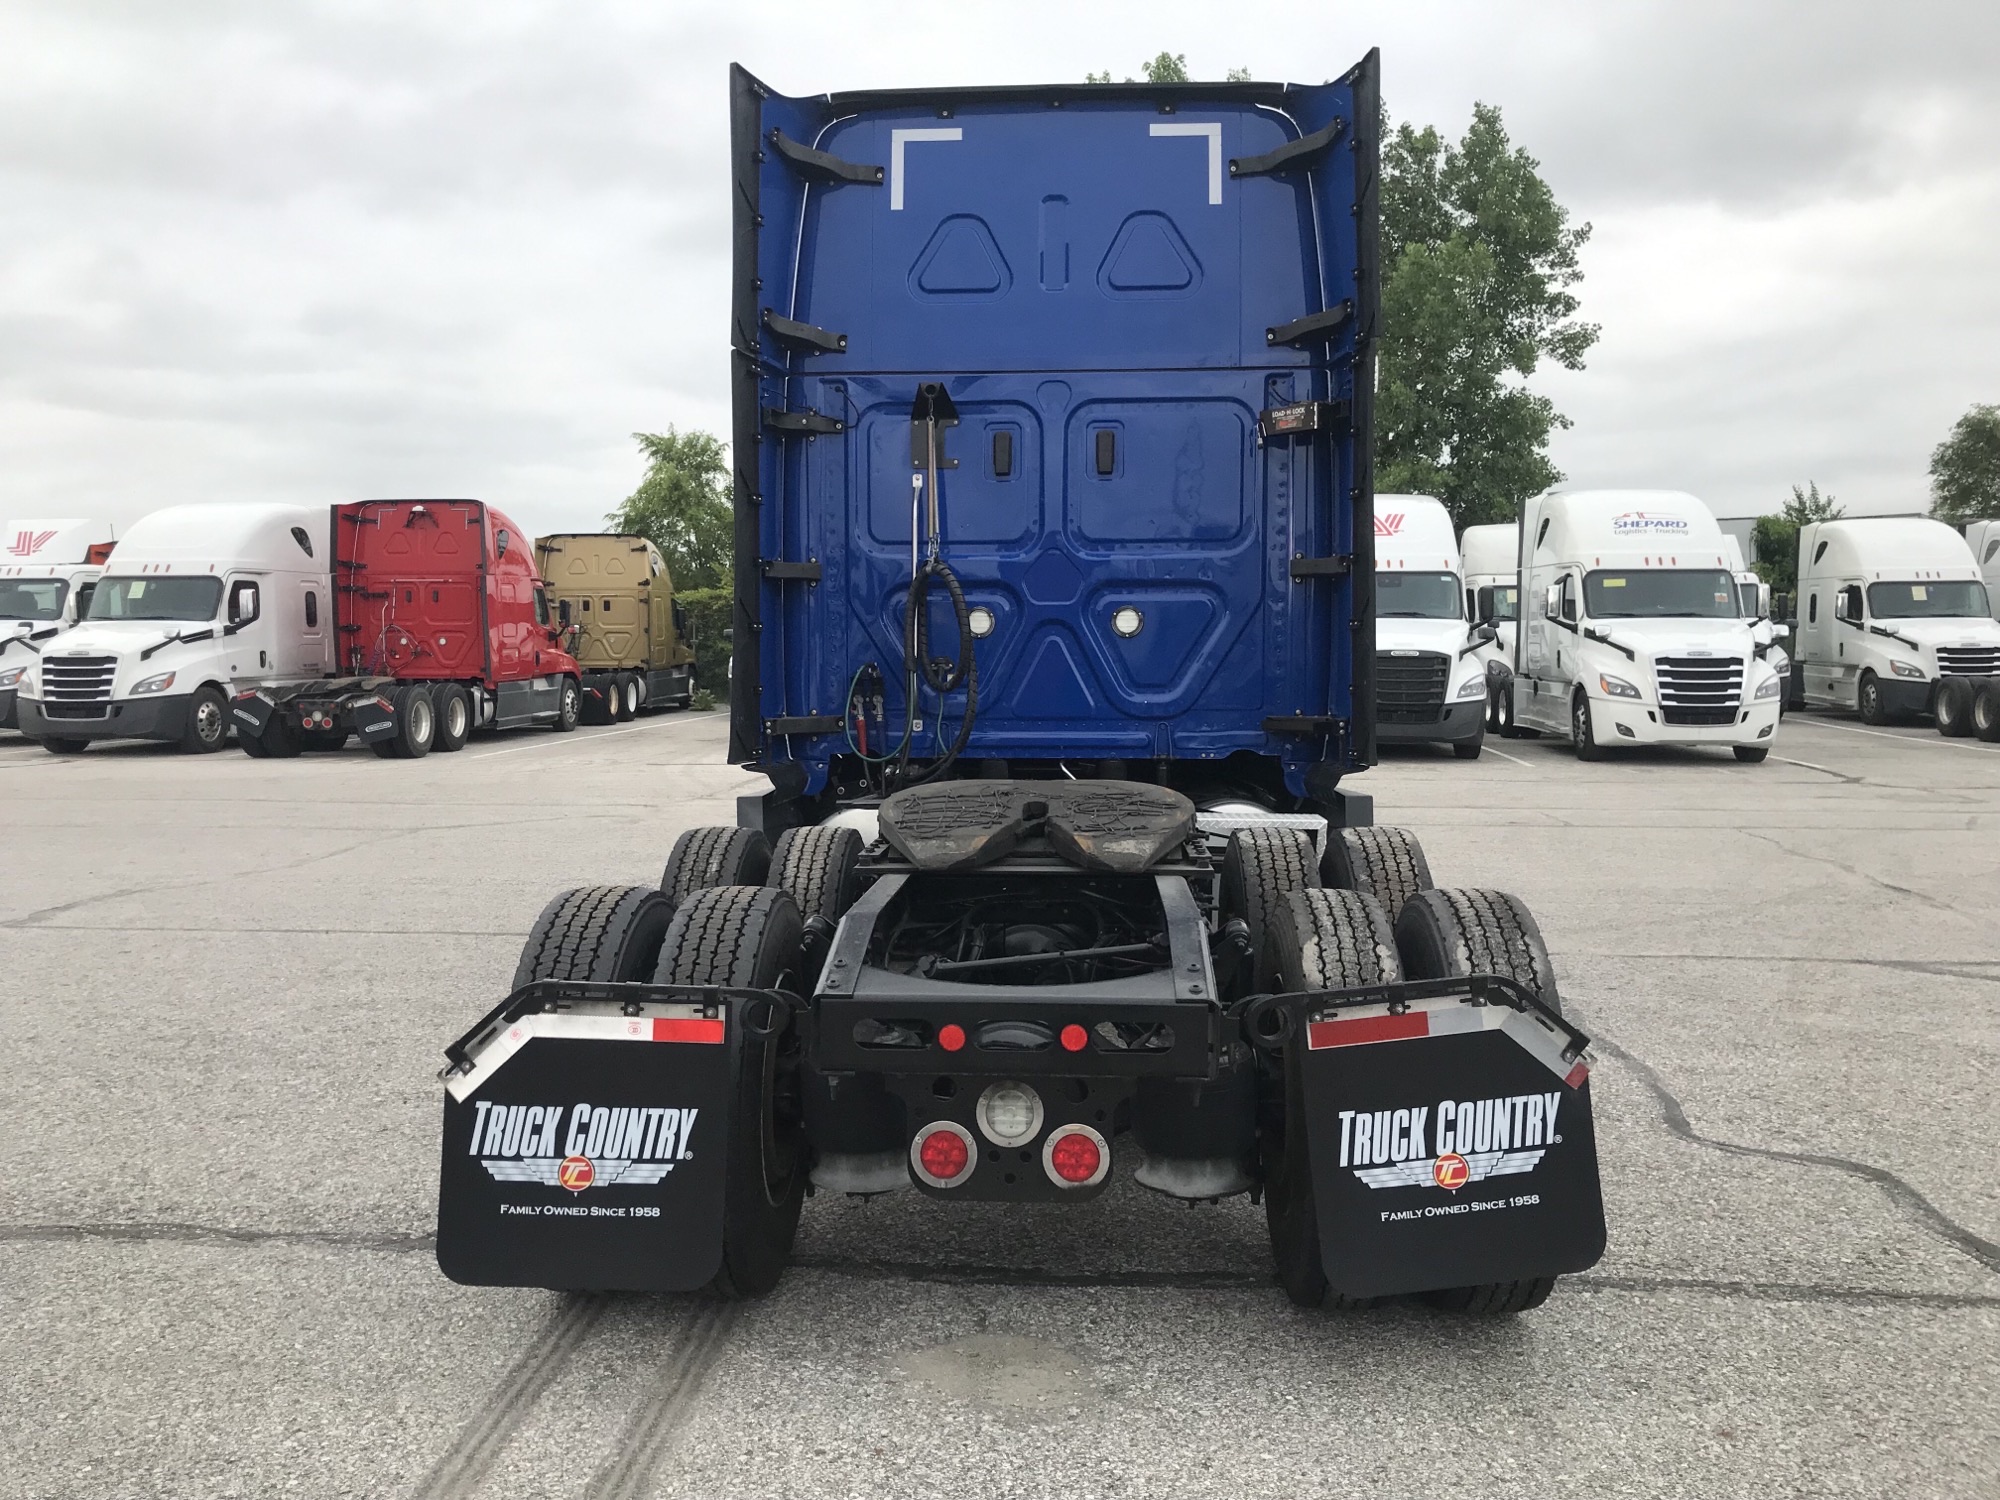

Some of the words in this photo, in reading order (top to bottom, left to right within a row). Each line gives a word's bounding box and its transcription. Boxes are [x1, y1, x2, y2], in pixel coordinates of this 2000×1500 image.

[1613, 520, 1688, 529] SHEPARD
[1614, 528, 1648, 536] Logistics
[1655, 528, 1689, 536] Trucking
[468, 1101, 563, 1157] TRUCK
[1338, 1106, 1429, 1167] TRUCK
[500, 1204, 542, 1215] FAMILY
[543, 1205, 589, 1216] OWNED
[590, 1206, 626, 1217] SINCE
[629, 1206, 661, 1217] 1958
[1380, 1209, 1423, 1222] FAMILY
[1424, 1204, 1469, 1217] OWNED
[1471, 1199, 1506, 1212] SINCE
[1509, 1194, 1540, 1207] 1958
